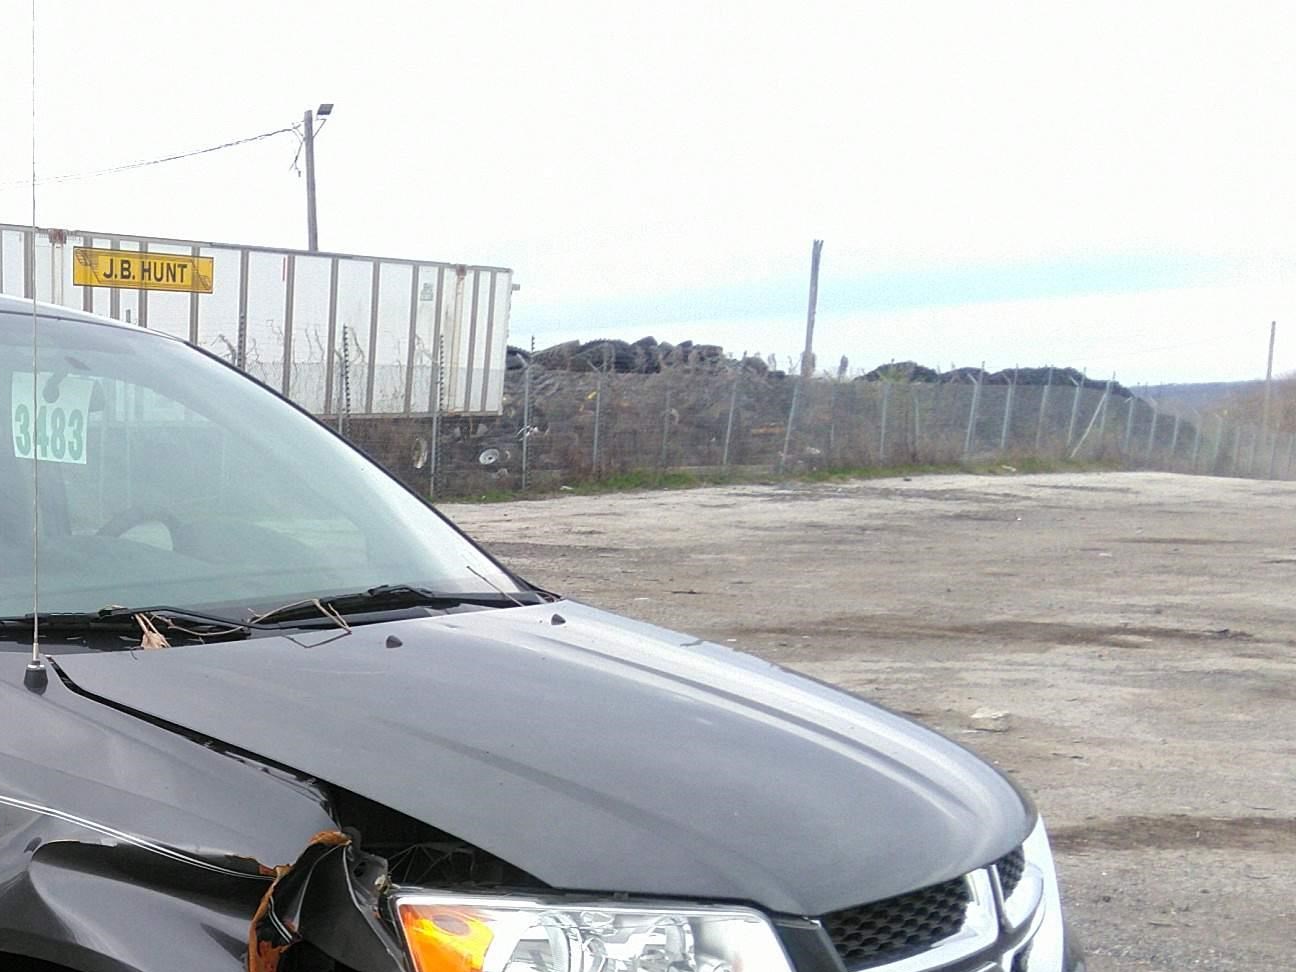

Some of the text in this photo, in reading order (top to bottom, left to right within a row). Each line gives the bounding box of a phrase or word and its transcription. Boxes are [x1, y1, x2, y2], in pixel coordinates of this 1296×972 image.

[103, 257, 188, 283] J.B. HUNT
[15, 403, 83, 461] 3483
